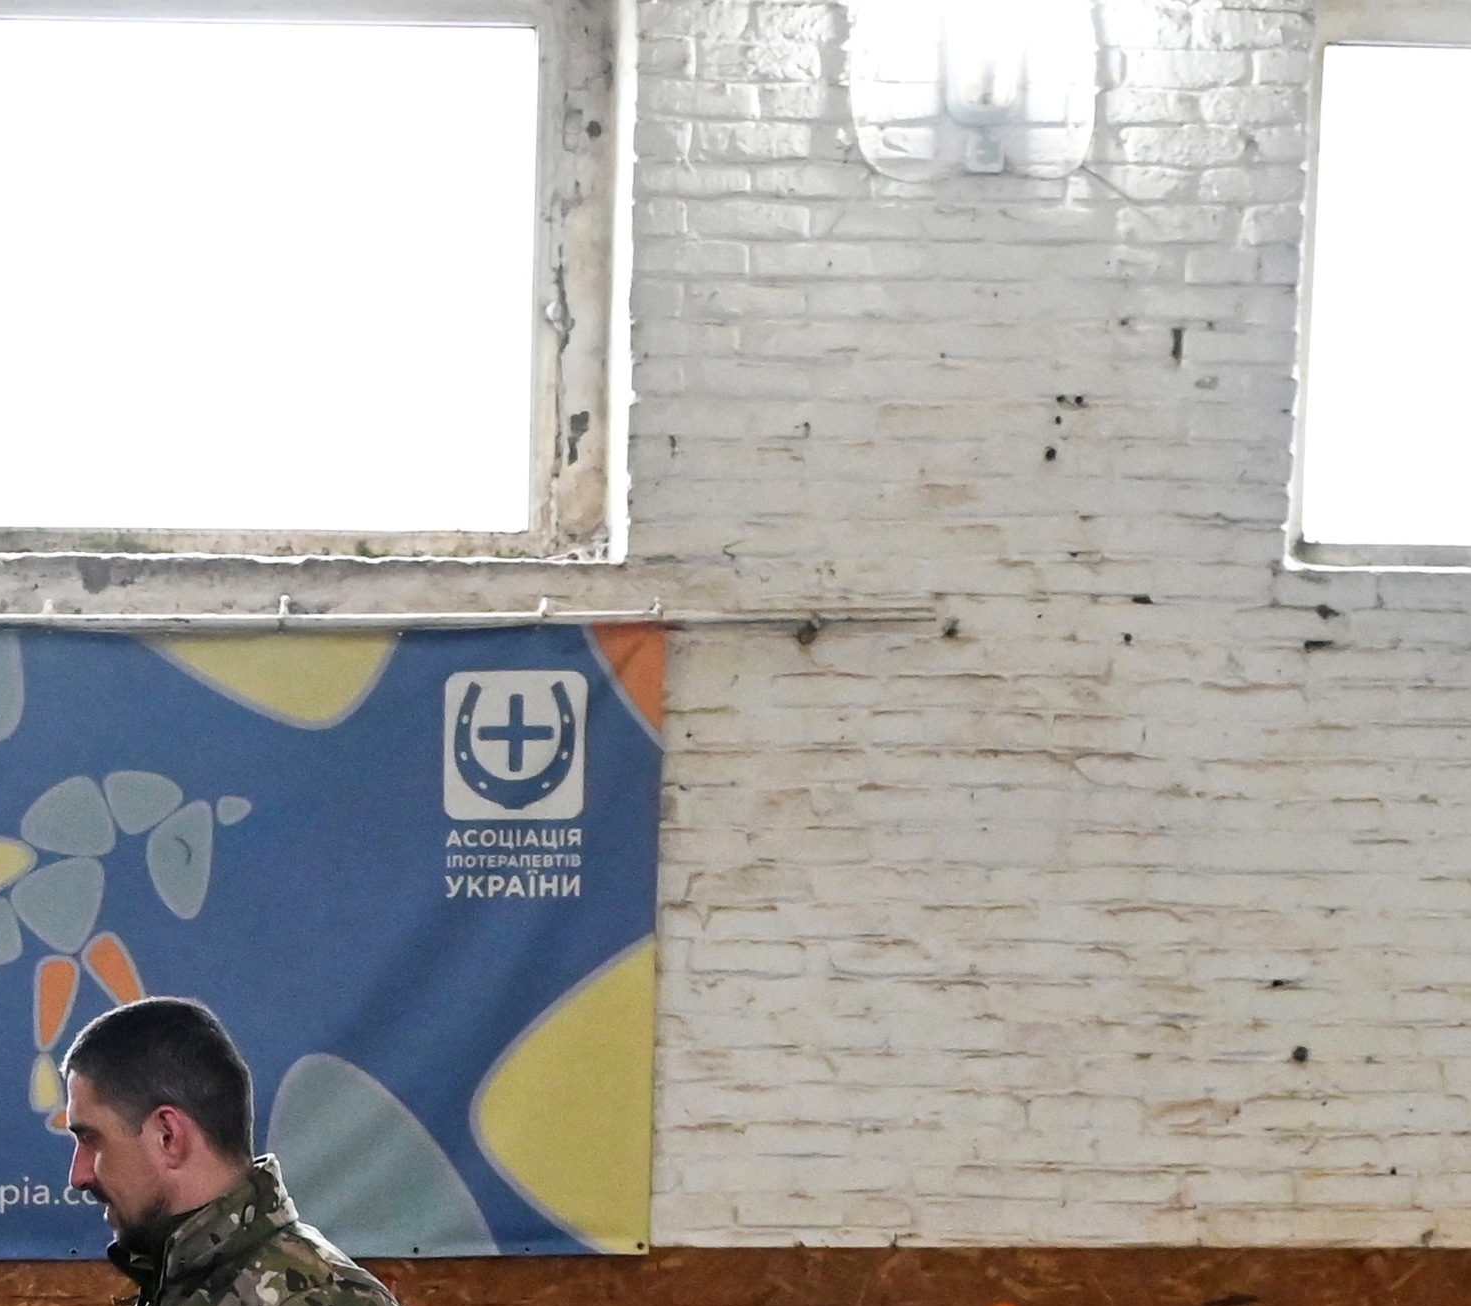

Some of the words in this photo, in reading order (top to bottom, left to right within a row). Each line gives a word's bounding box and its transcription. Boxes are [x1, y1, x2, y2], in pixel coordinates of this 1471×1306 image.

[446, 828, 583, 849] АСОЦІАЦІЯ
[446, 854, 582, 869] ІПОТЕРАПЕВТІВ
[445, 870, 581, 898] УКРАЇНИ
